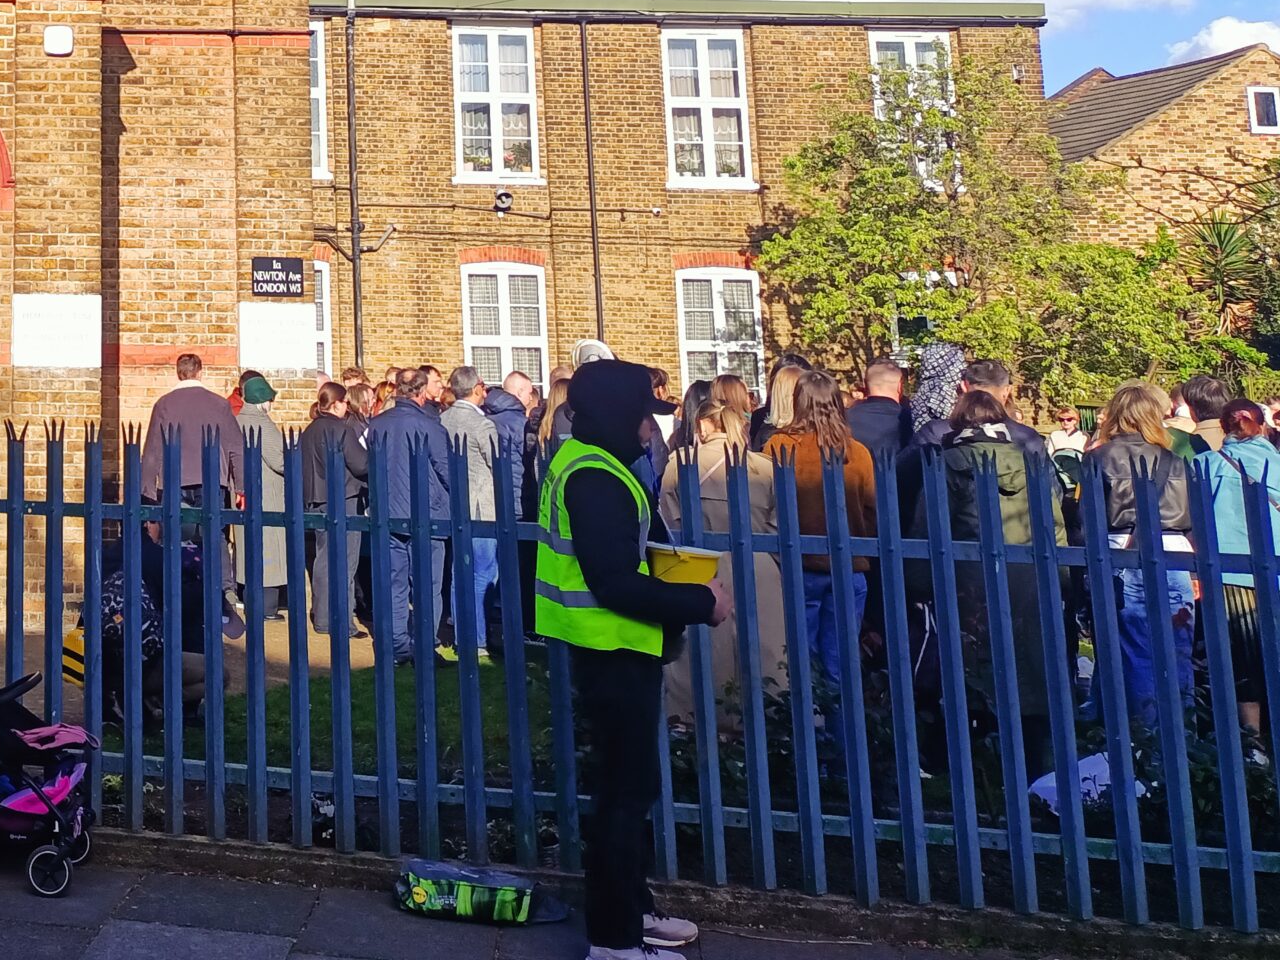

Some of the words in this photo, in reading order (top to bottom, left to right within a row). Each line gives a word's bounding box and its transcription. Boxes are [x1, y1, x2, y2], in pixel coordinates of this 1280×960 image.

[253, 270, 286, 281] NEWTON
[288, 271, 302, 282] Ave
[254, 283, 287, 293] LONDON
[289, 283, 302, 293] W3
